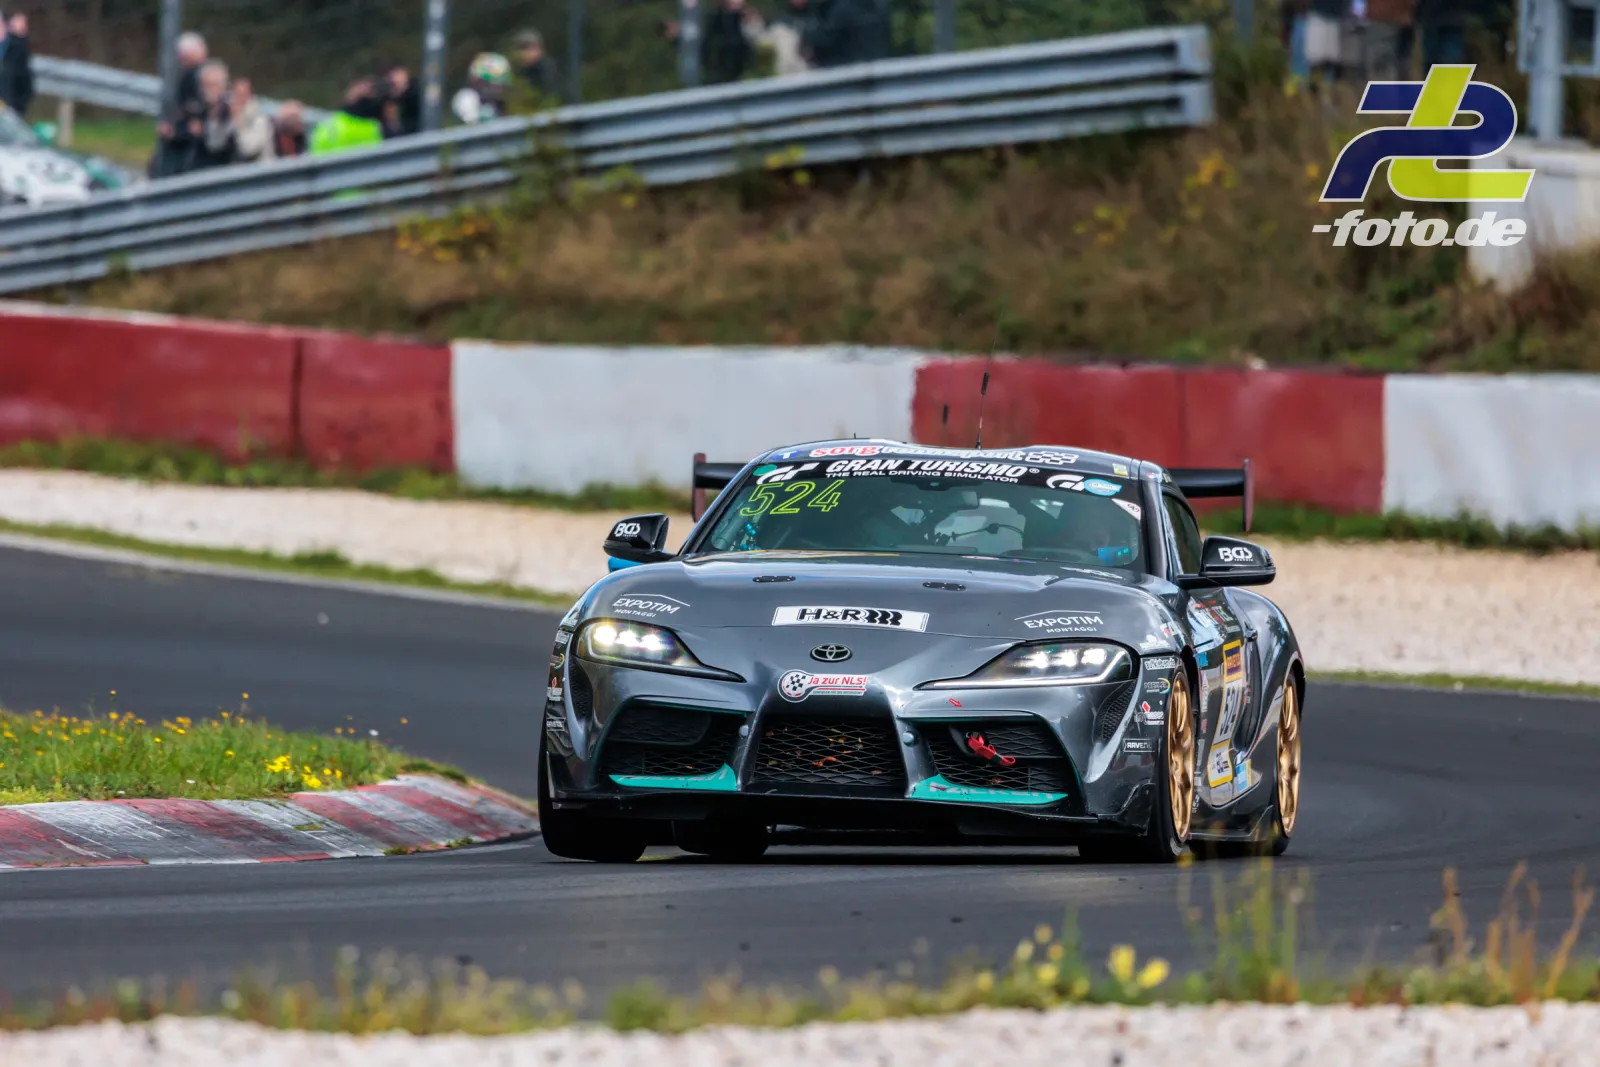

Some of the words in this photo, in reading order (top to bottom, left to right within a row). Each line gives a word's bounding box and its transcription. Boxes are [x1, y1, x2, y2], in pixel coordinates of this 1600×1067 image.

[825, 459, 906, 473] GRAN
[944, 472, 1019, 483] SIMULATOR
[739, 479, 846, 517] 524
[1218, 546, 1253, 562] BGS
[612, 598, 681, 614] EXPOTIM
[614, 608, 657, 618] MONTAGGI
[797, 607, 862, 622] H&R
[1023, 615, 1104, 629] EXPOTIM
[1046, 626, 1098, 634] MONTAGGI
[807, 676, 820, 685] Ja
[821, 677, 840, 685] zur
[841, 676, 867, 686] NLS!
